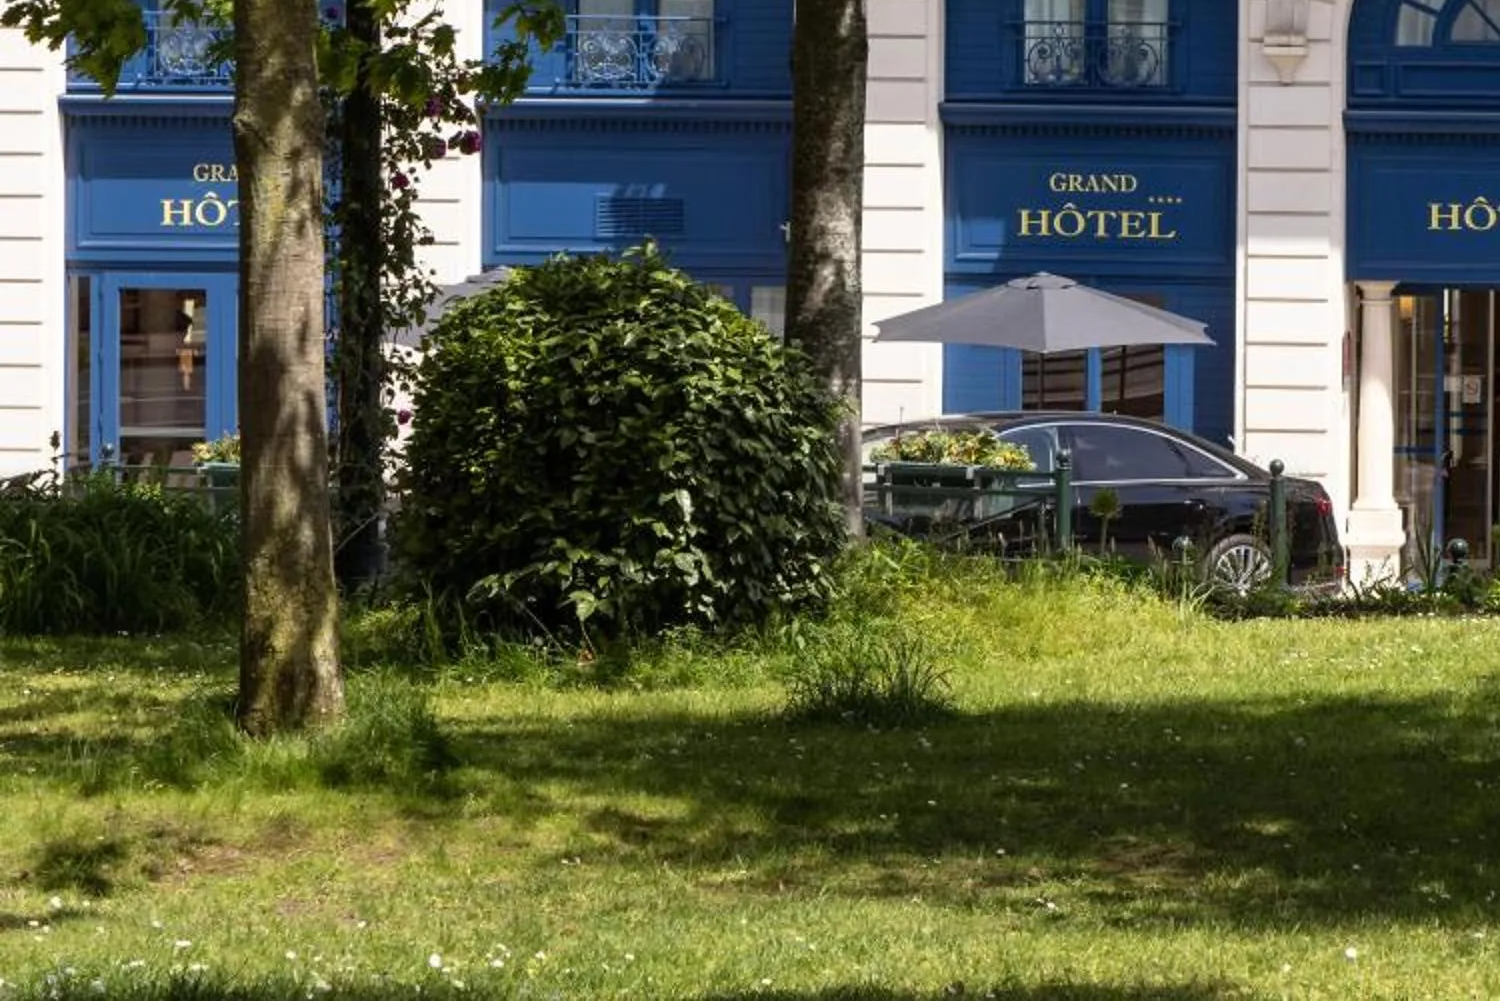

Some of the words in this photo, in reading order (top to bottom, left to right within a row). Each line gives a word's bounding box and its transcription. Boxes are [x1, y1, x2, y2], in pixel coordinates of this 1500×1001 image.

[193, 163, 239, 183] GRA
[1050, 172, 1138, 193] GRAND
[1017, 202, 1177, 238] HÔTEL
